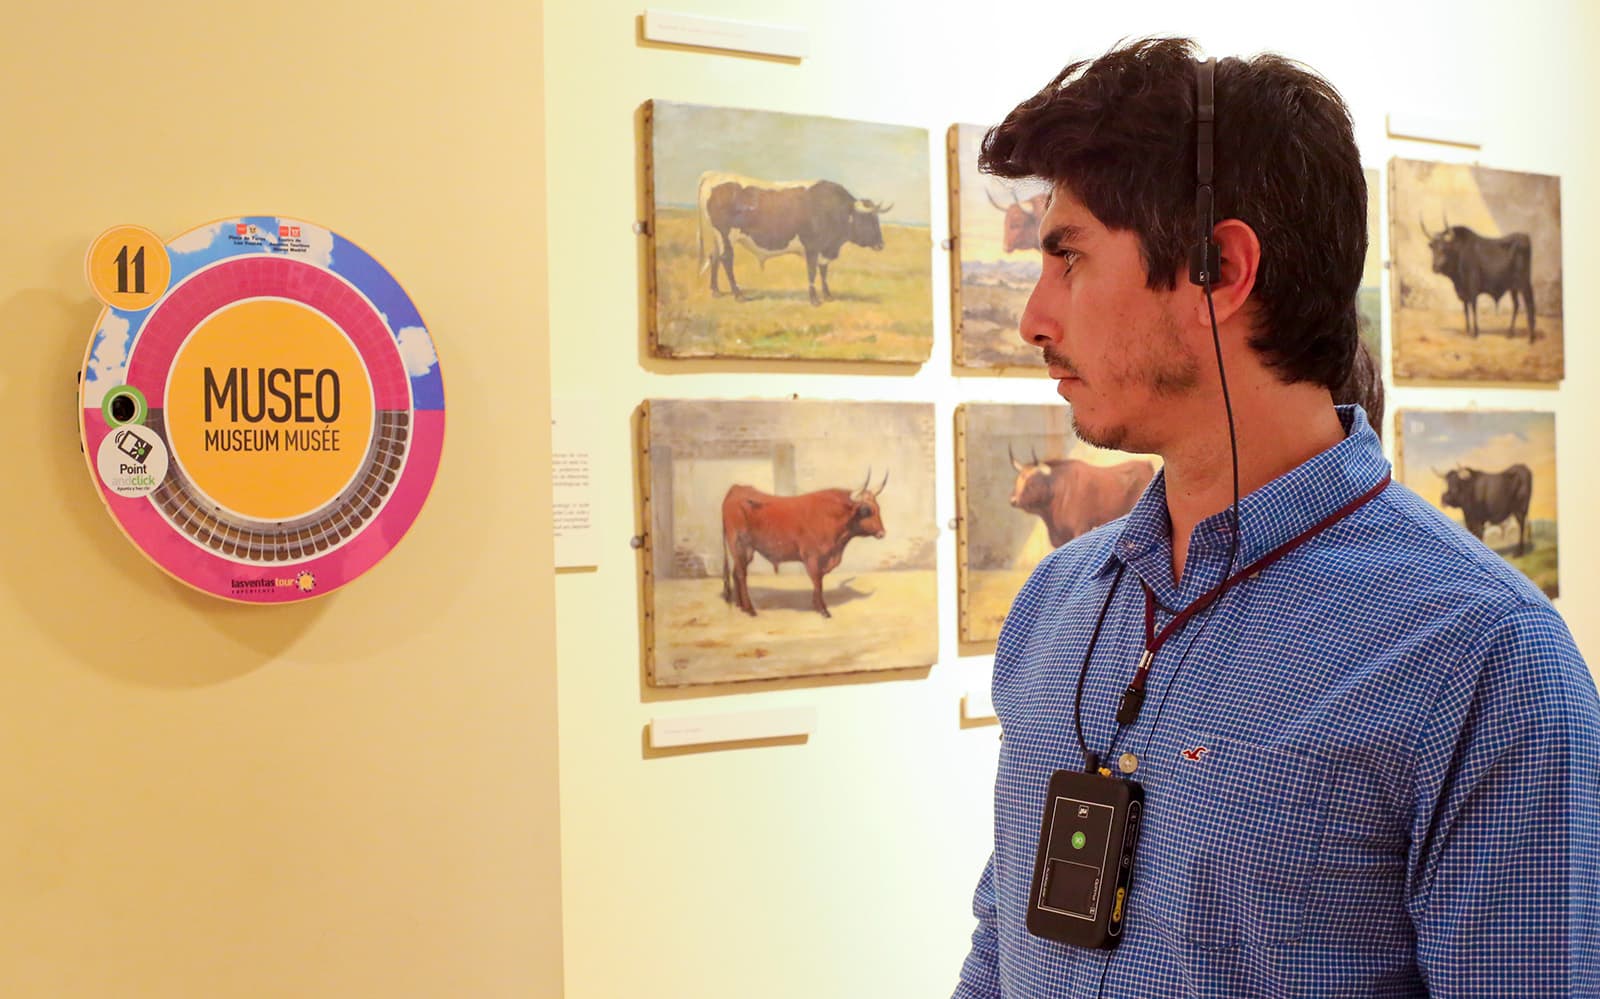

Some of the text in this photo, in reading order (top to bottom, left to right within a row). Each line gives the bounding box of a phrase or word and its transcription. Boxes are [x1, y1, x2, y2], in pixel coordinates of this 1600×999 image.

[112, 245, 150, 294] 11
[203, 367, 341, 424] MUSEO
[204, 424, 341, 452] MUSEUM MUSÉE
[119, 463, 147, 474] Point
